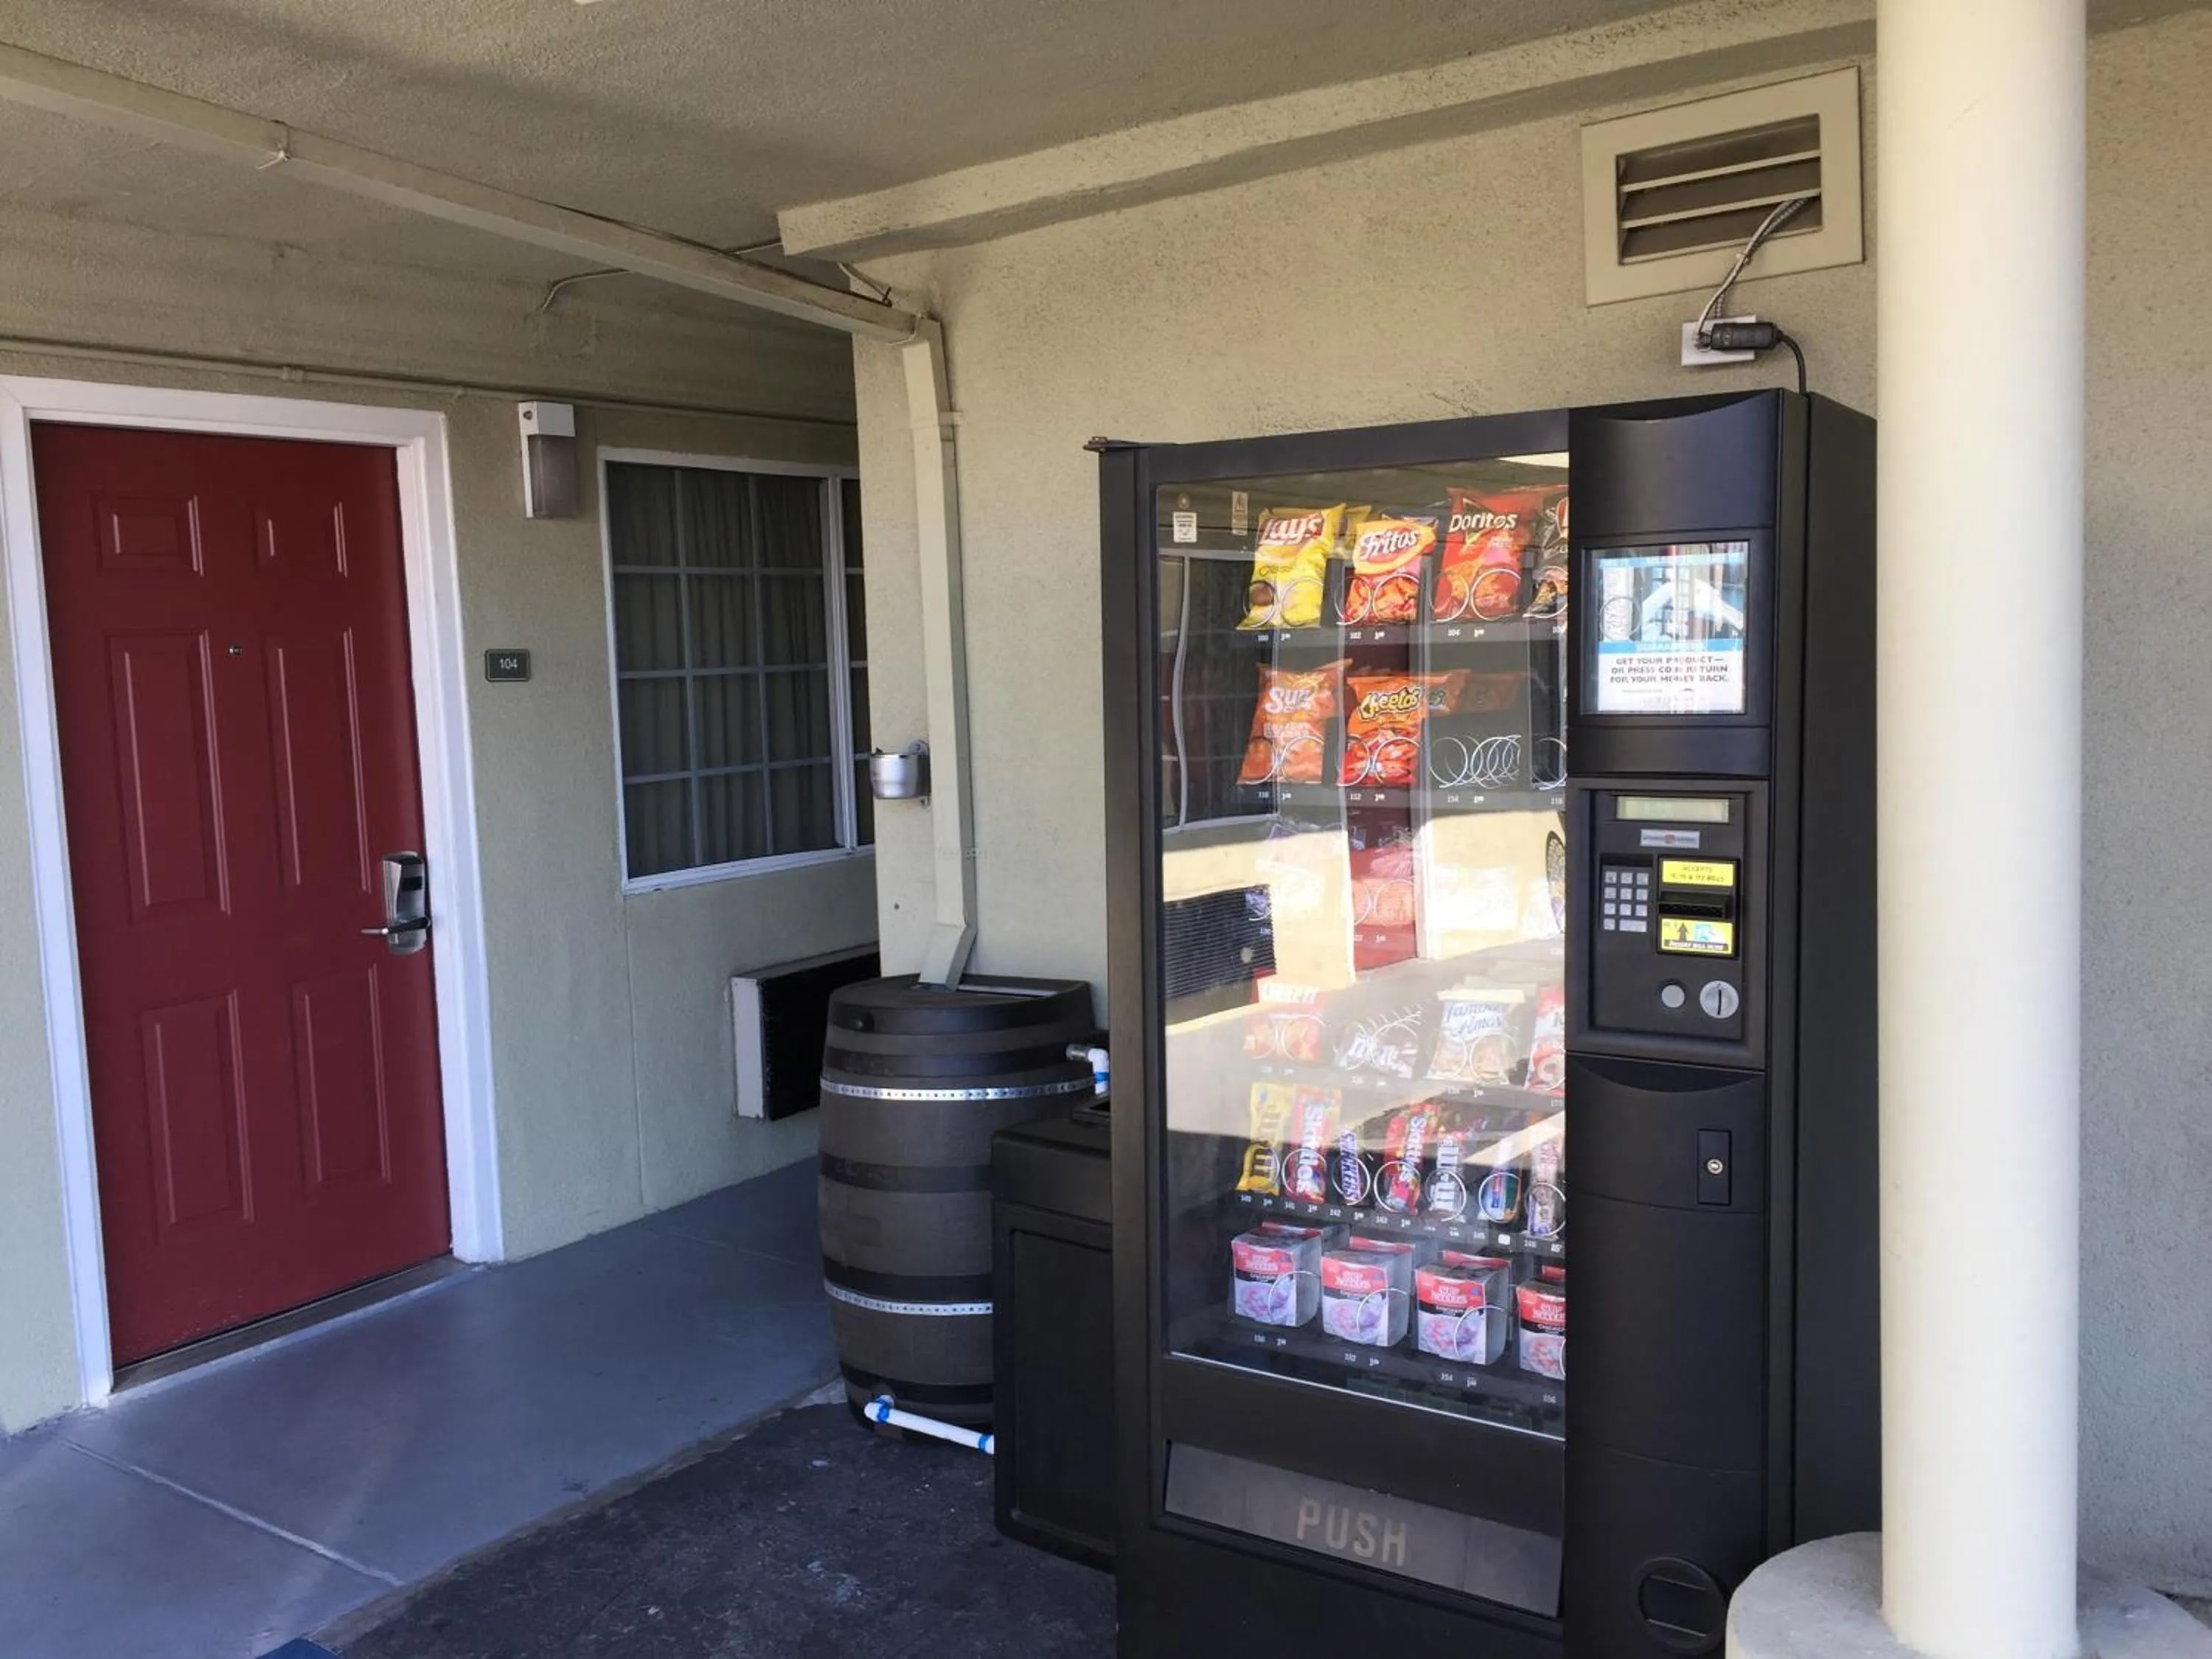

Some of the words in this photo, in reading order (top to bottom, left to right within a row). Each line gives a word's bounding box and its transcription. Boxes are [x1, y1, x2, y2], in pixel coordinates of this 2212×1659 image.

[1448, 512, 1518, 532] Doritos
[1360, 529, 1419, 560] Fritos
[500, 658, 518, 669] 104
[1360, 686, 1421, 720] Cheetos
[1296, 1498, 1409, 1567] PUSH
